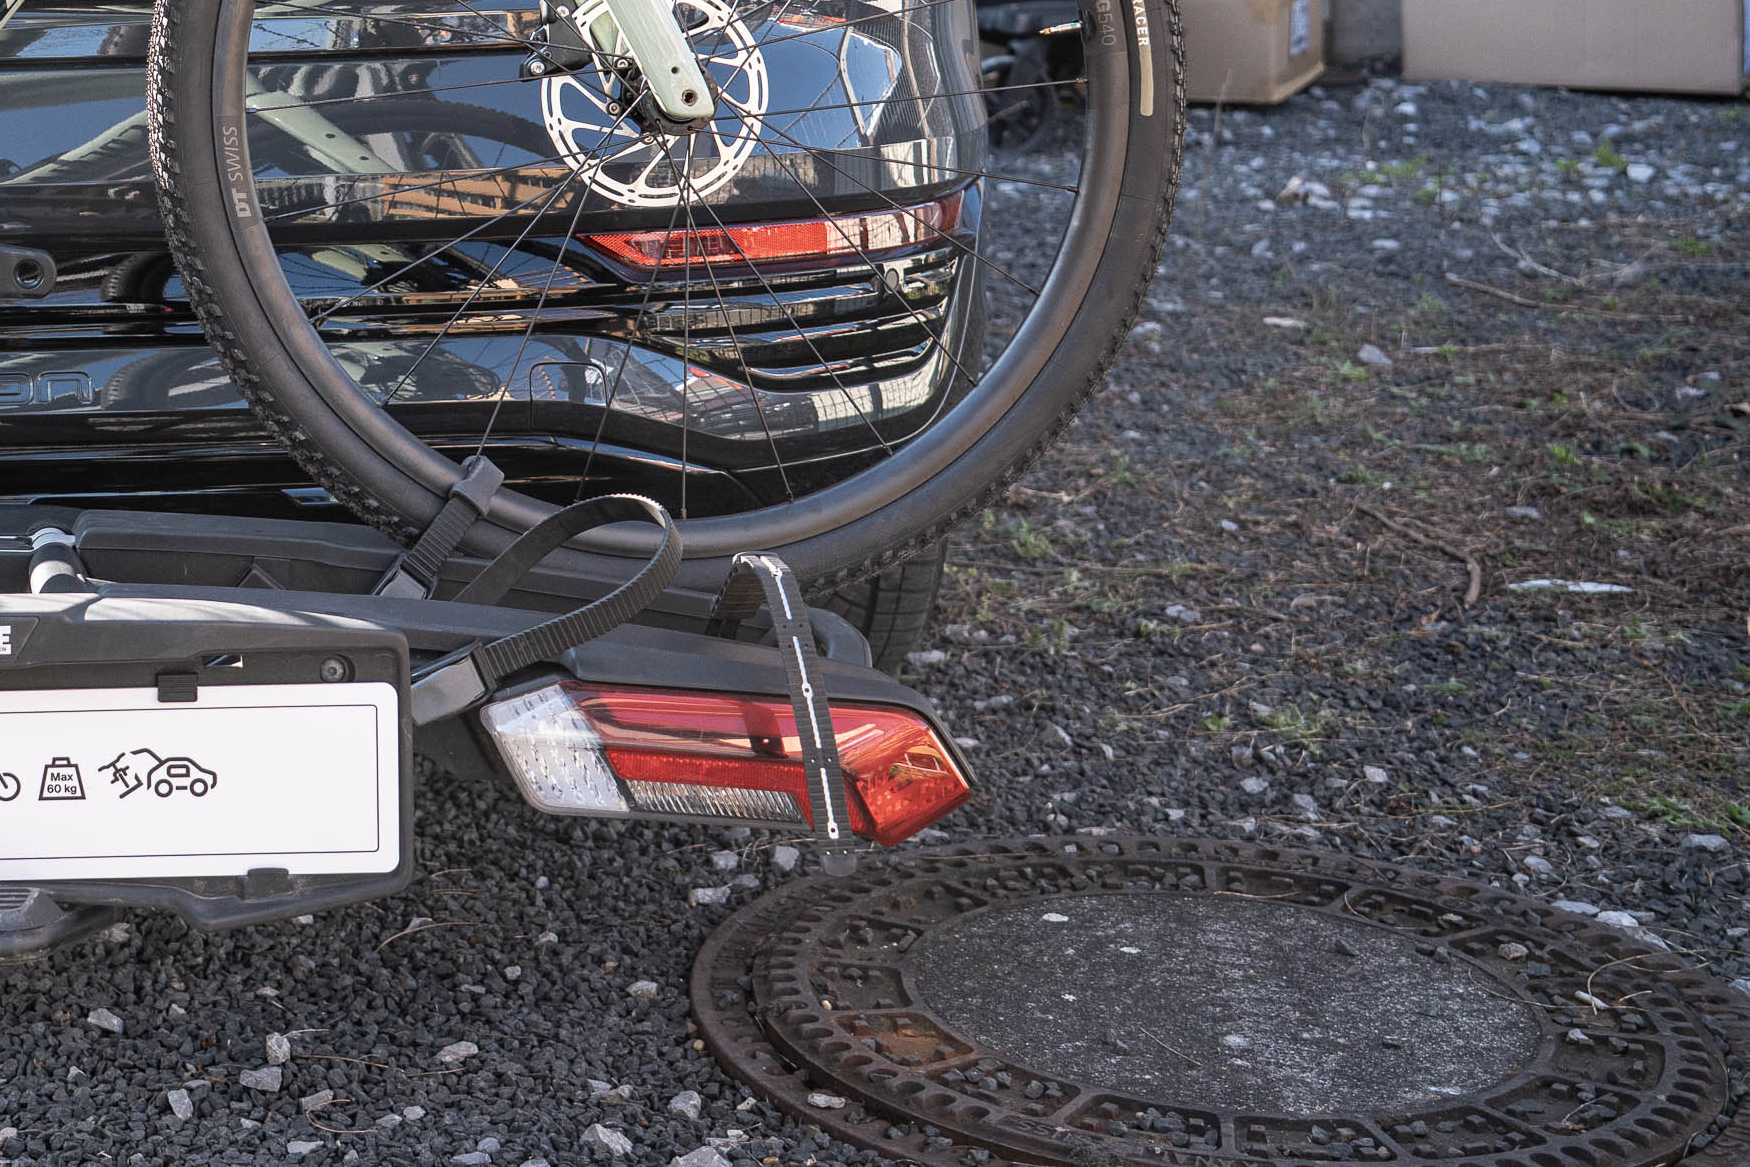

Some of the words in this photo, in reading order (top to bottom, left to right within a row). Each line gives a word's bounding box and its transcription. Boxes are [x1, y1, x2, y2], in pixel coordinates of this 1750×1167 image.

[1096, 0, 1116, 46] G540
[223, 126, 243, 182] SWISS
[231, 187, 251, 218] DT
[47, 784, 61, 794] 60
[64, 783, 77, 794] kg
[50, 772, 74, 782] Max
